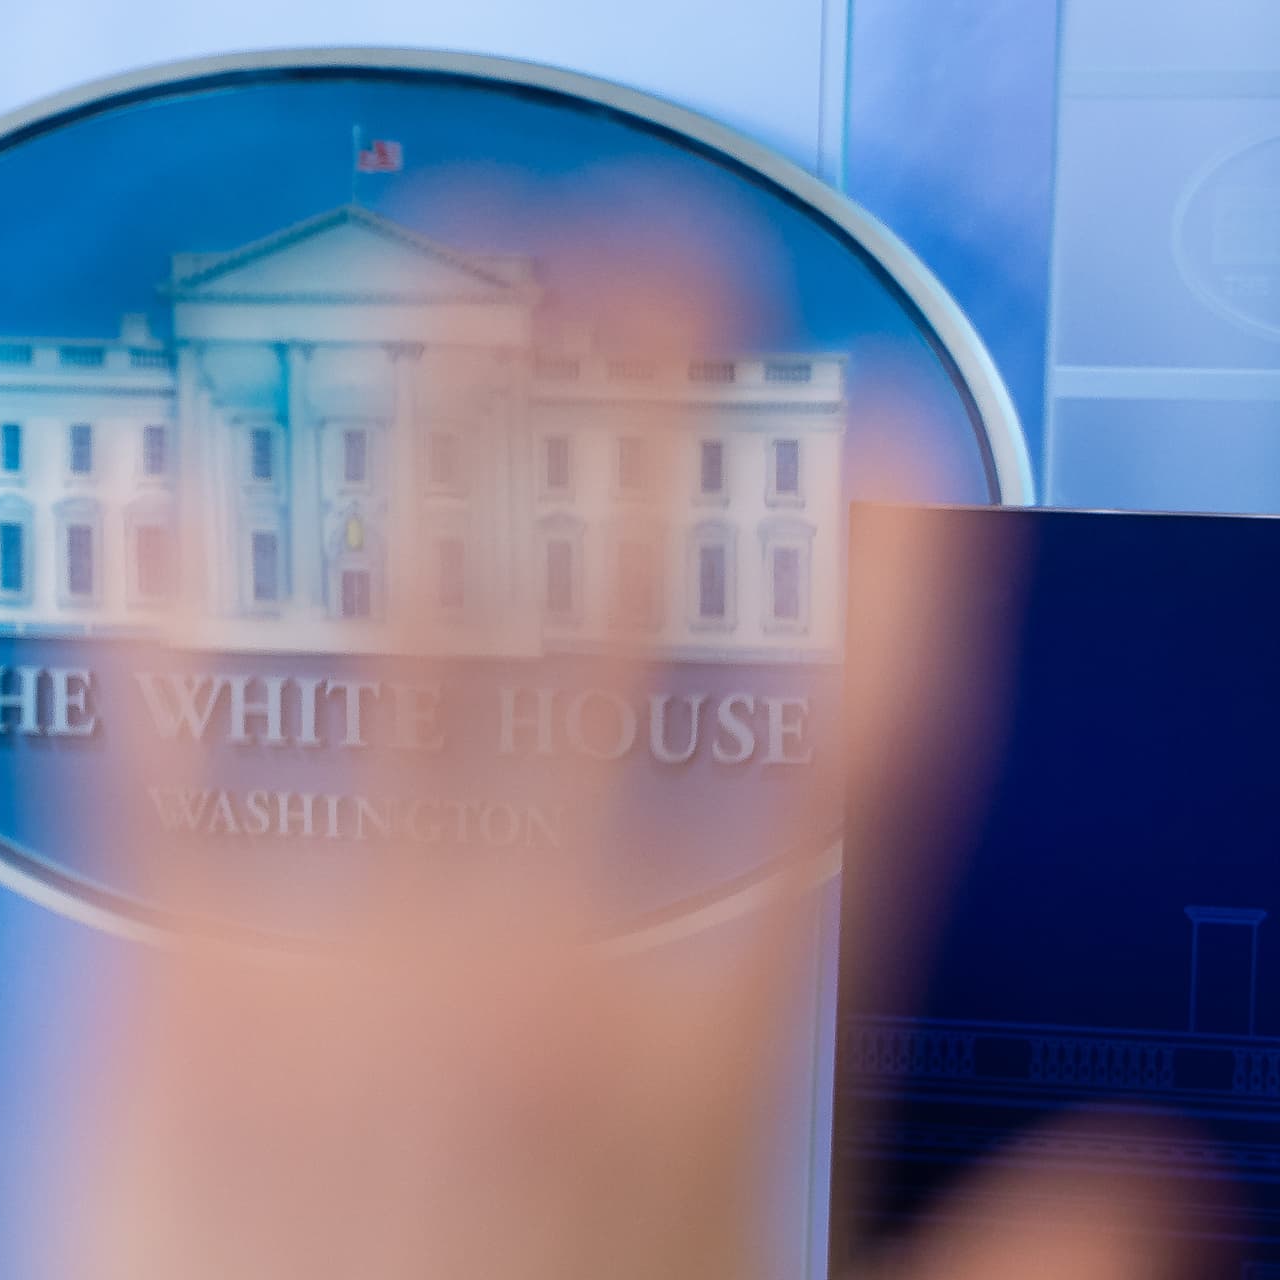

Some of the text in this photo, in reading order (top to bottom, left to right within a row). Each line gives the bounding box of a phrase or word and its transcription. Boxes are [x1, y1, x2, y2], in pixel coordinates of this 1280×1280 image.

[134, 671, 446, 752] WHITE
[500, 686, 816, 768] HOUSE
[147, 784, 566, 849] WASHINGTON
